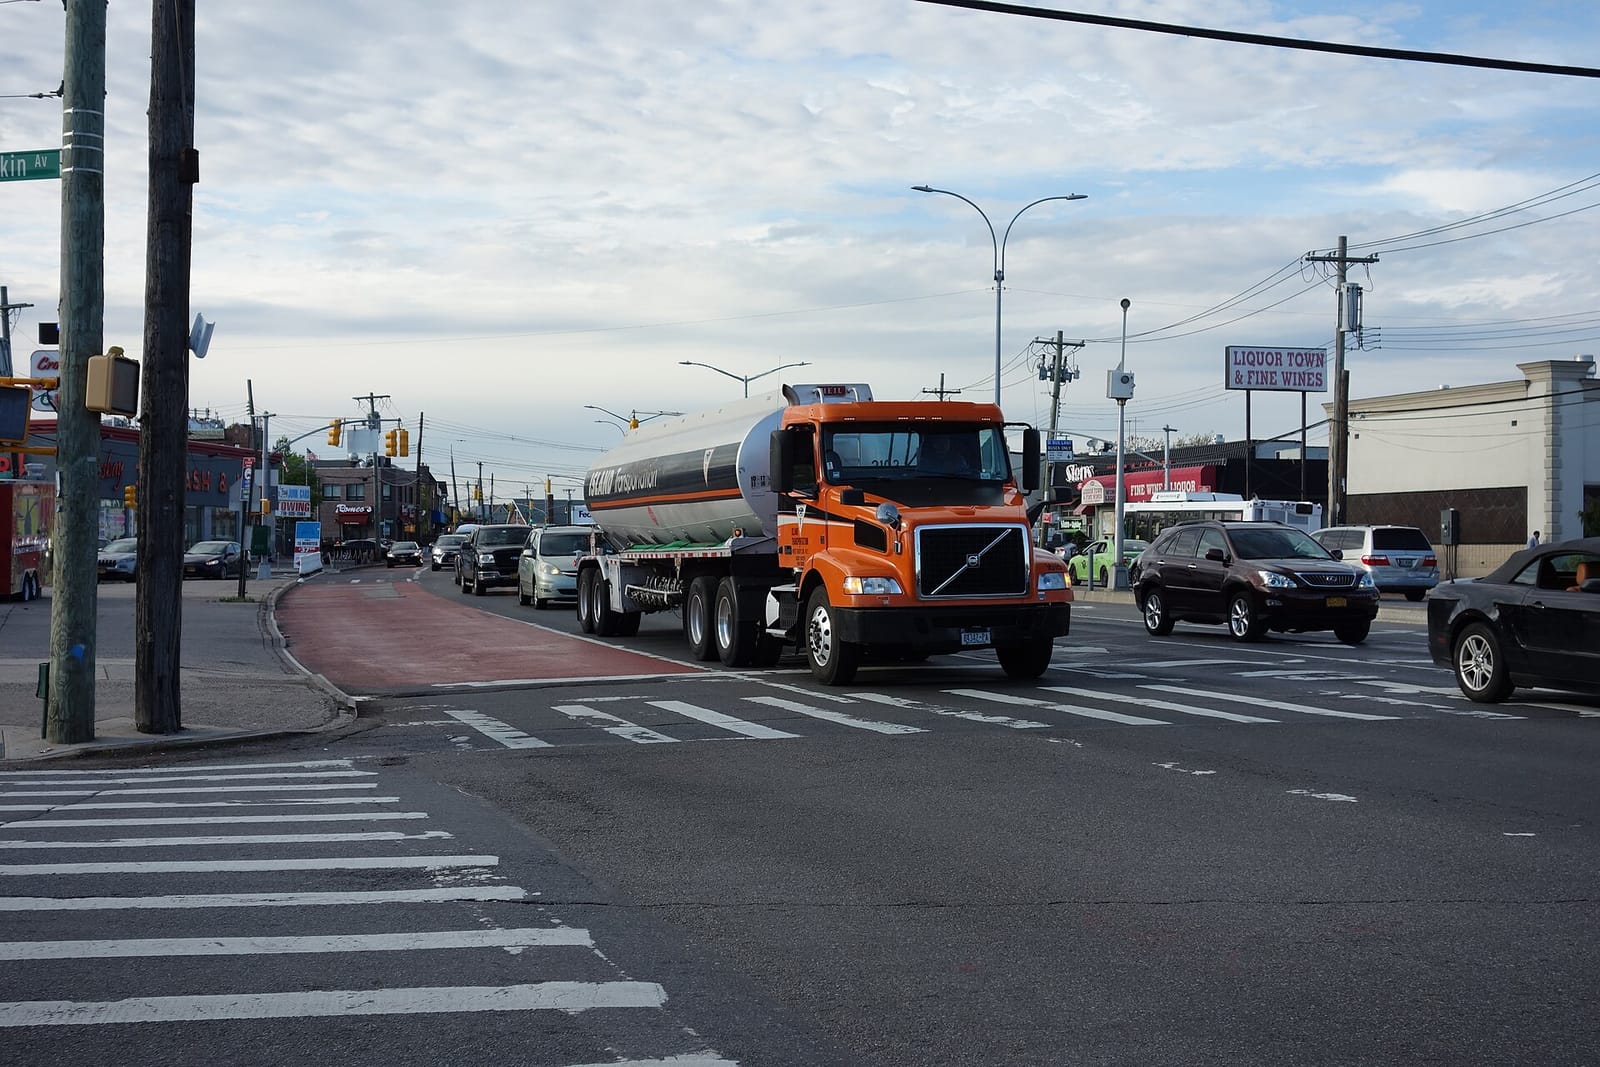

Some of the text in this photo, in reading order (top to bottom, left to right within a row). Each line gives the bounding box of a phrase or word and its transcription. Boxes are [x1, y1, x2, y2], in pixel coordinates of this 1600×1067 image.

[34, 154, 47, 168] Av
[1233, 351, 1325, 368] LIQUOR TOWN
[1234, 369, 1323, 387] & FINE WINES
[185, 469, 212, 491] ASH
[588, 469, 615, 497] ISLAND
[1130, 484, 1146, 497] FINE
[1170, 480, 1196, 493] LIQUOR
[281, 501, 310, 512] OWING
